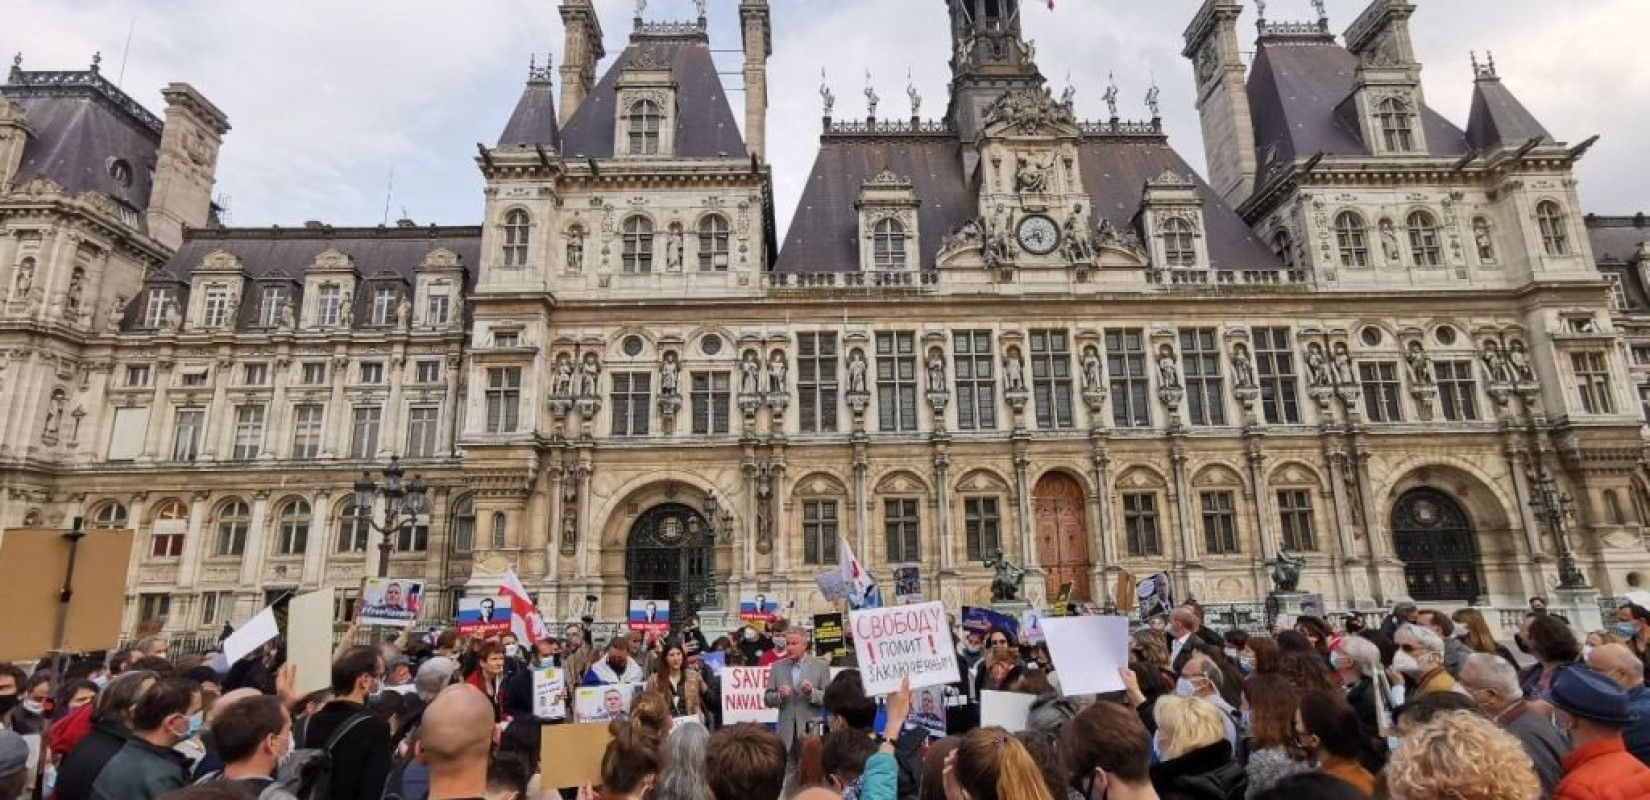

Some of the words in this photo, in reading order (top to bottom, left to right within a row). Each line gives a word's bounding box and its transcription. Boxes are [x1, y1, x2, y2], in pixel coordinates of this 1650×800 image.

[856, 608, 941, 639] СВОБОДУ
[879, 636, 923, 658] ПОЛИТ
[732, 668, 770, 688] SAVE
[725, 694, 766, 710] NAVAL
